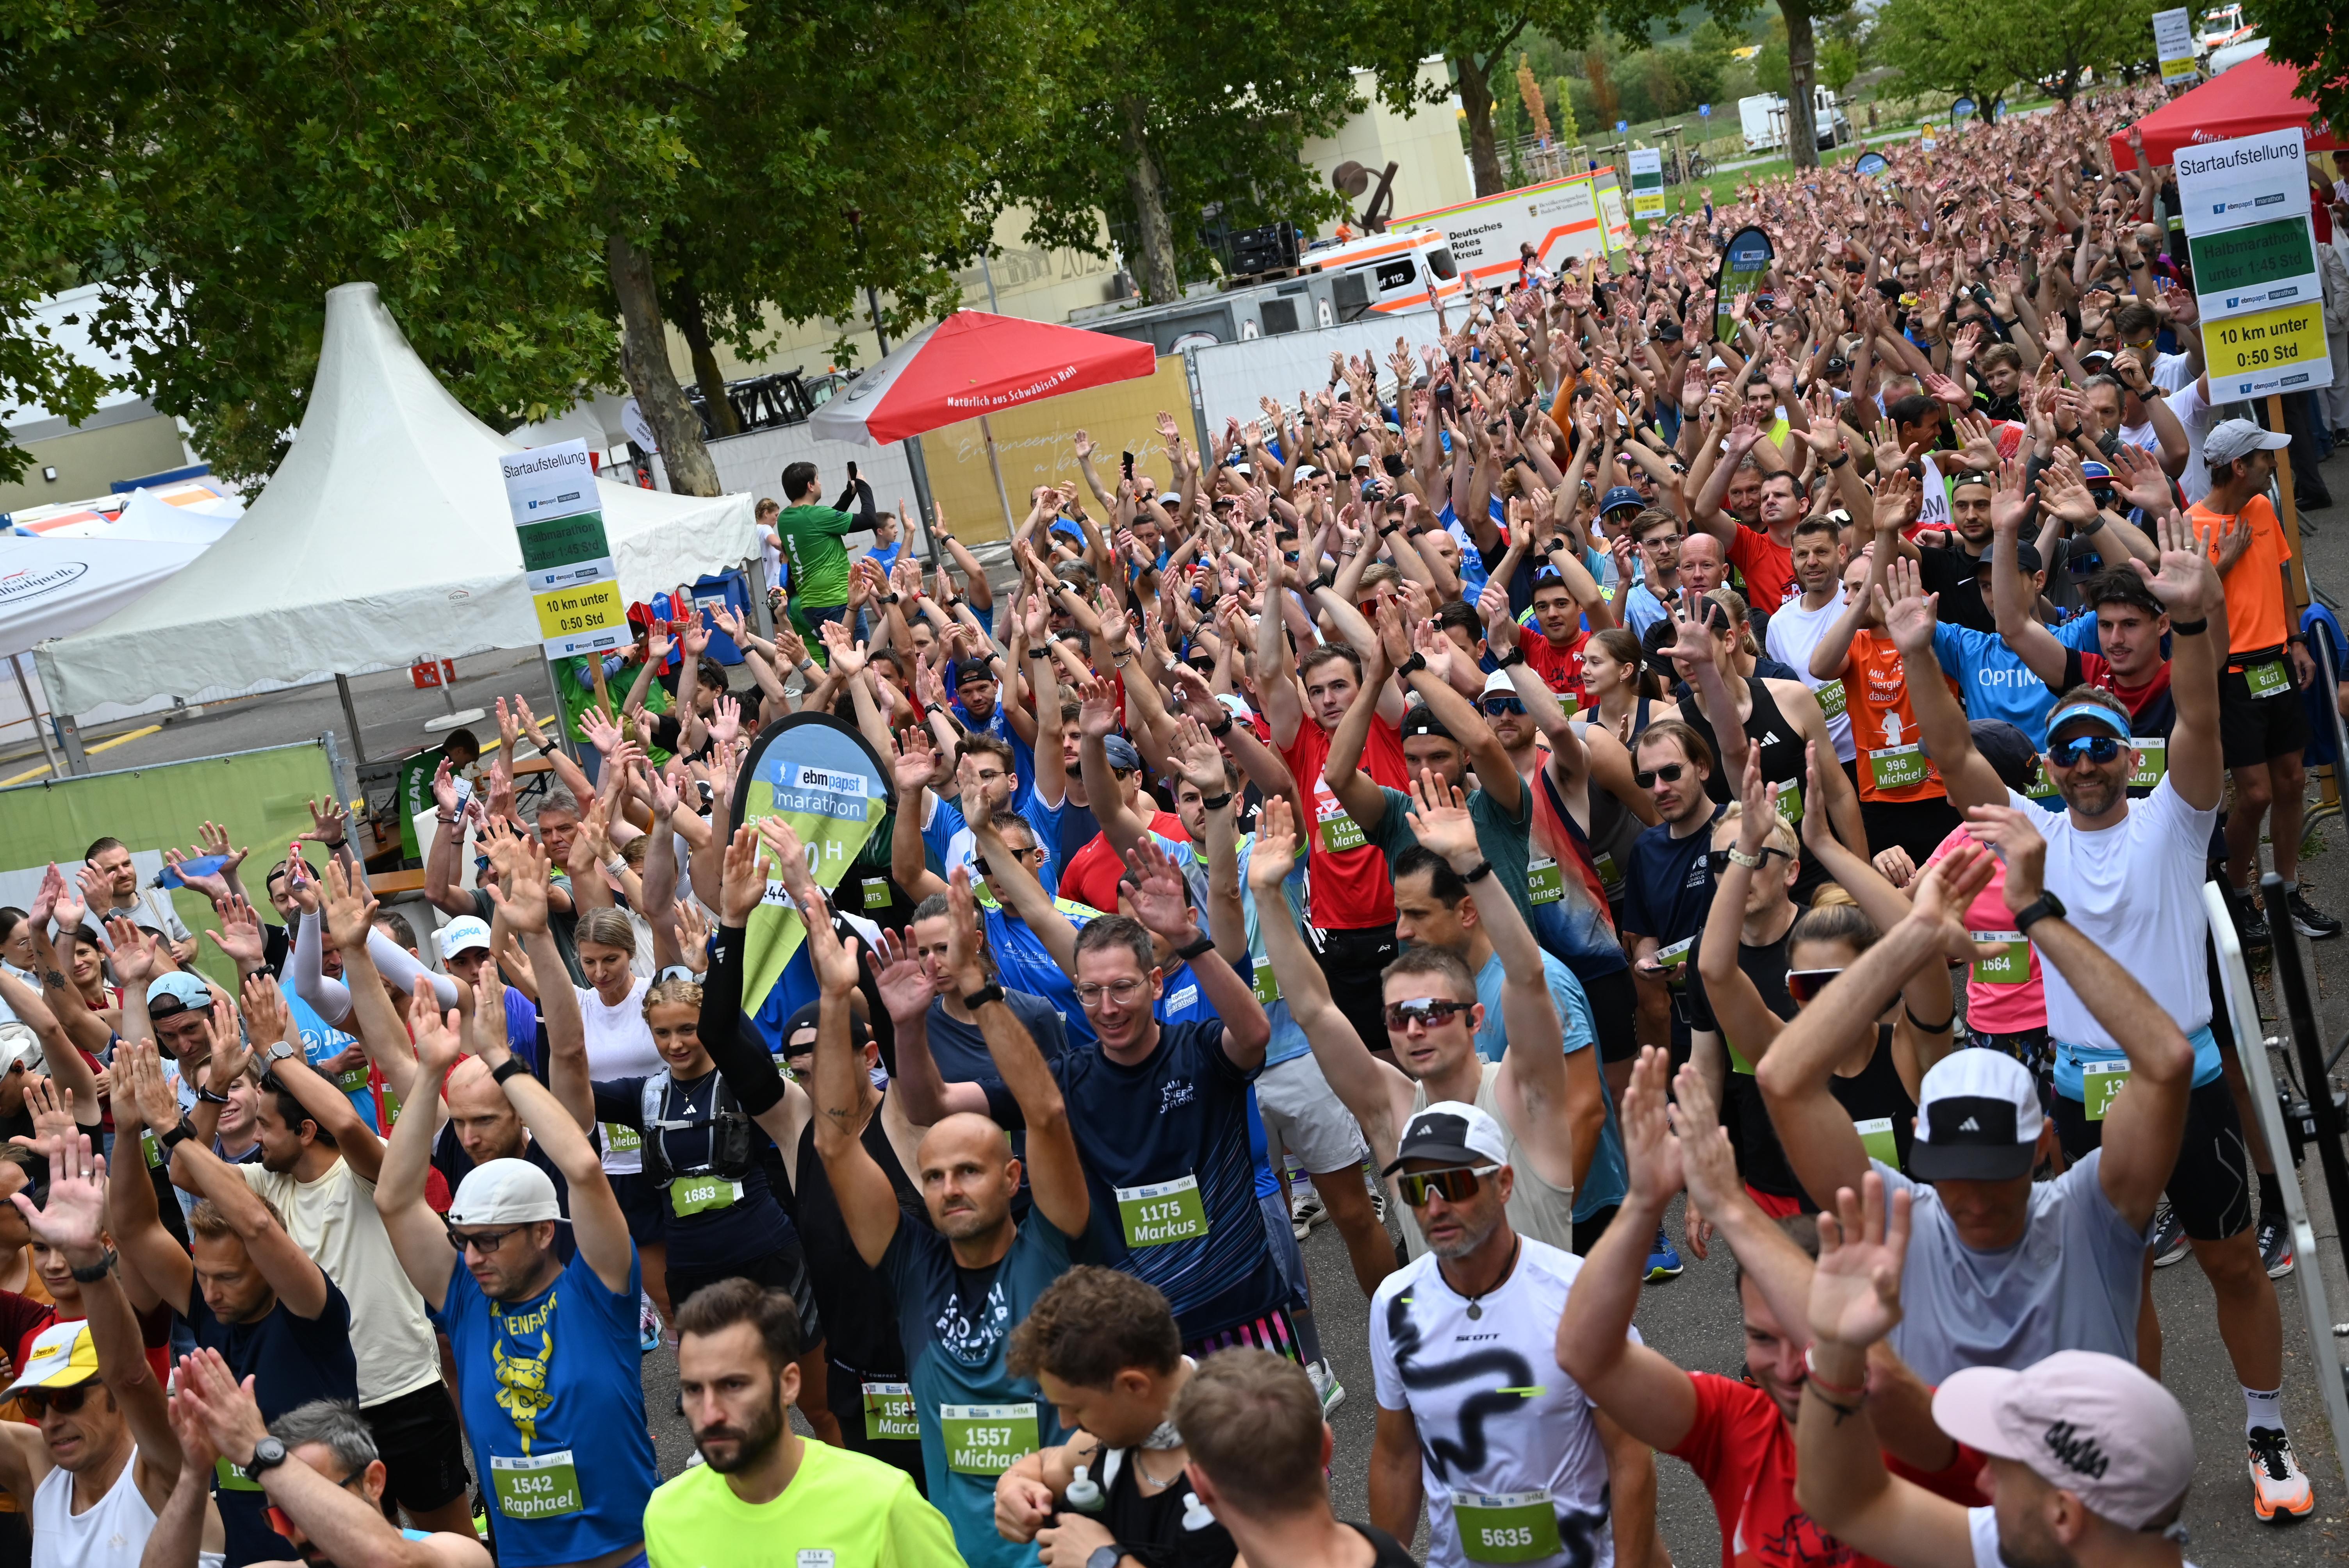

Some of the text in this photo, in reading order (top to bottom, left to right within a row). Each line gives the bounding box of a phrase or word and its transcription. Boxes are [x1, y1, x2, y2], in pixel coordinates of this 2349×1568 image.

[2180, 143, 2299, 176] Startaufstellung
[1539, 192, 1587, 208] Bevölkerungsschutz
[1540, 200, 1589, 215] Baden-Württemberg
[2228, 194, 2283, 211] ebmpapst marathon
[1449, 222, 1502, 240] Deutsches
[1451, 239, 1481, 251] Rotes
[2204, 231, 2298, 259] Halbmarathon
[1454, 248, 1483, 260] Kreuz
[1743, 251, 1763, 260] ebmpapst
[1734, 261, 1762, 270] marathon
[2208, 252, 2302, 283] unter 1:45 Std
[1390, 273, 1405, 284] 112
[2241, 288, 2296, 305] ebmpapst marathon
[2220, 318, 2308, 345] 10 km unter
[2237, 342, 2298, 367] 0:50 Std
[947, 365, 1077, 408] Natürlich aus Schwäbisch Hall
[2253, 374, 2307, 390] ebmpapst marathon
[958, 426, 1078, 463] Enineerin
[504, 451, 586, 478] Startaufstellung
[1034, 463, 1049, 472] a
[538, 492, 579, 506] ebmpapst marathon
[527, 523, 595, 544] Halbmarathon
[531, 540, 599, 562] unter 1:45 Std
[556, 568, 597, 581] ebmpapst marathon
[547, 593, 609, 613] 10 km unter
[560, 613, 604, 631] 0:50 Std
[594, 638, 613, 647] marathon
[1868, 668, 1884, 680] Mit
[1978, 667, 2045, 688] OPTIM
[2259, 672, 2279, 686] 1378
[1868, 679, 1902, 690] Energie
[1869, 690, 1897, 701] dabei!
[1886, 759, 1907, 772] 996
[803, 769, 860, 792] ebmpapst
[1879, 767, 1922, 786] Michael
[409, 767, 424, 815] EAM
[777, 791, 860, 817] marathon
[826, 840, 842, 860] H
[864, 893, 882, 902] 1675
[451, 927, 481, 943] HOKA
[1013, 949, 1049, 961] POLIZEI
[1982, 957, 2010, 971] 1664
[1172, 987, 1194, 1000] ebmpapst
[1169, 1094, 1196, 1108] FLOW.
[1178, 1180, 1191, 1189] HM
[684, 1186, 716, 1204] 1683
[1140, 1200, 1181, 1222] 1175
[1135, 1219, 1196, 1242] Markus
[1454, 1333, 1500, 1342] SCOTT
[2247, 1390, 2279, 1400] cep
[966, 1427, 1012, 1446] 1557
[551, 1454, 565, 1463] HM
[512, 1475, 554, 1493] 1542
[504, 1489, 574, 1517] Raphael
[1481, 1527, 1533, 1547] 5635
